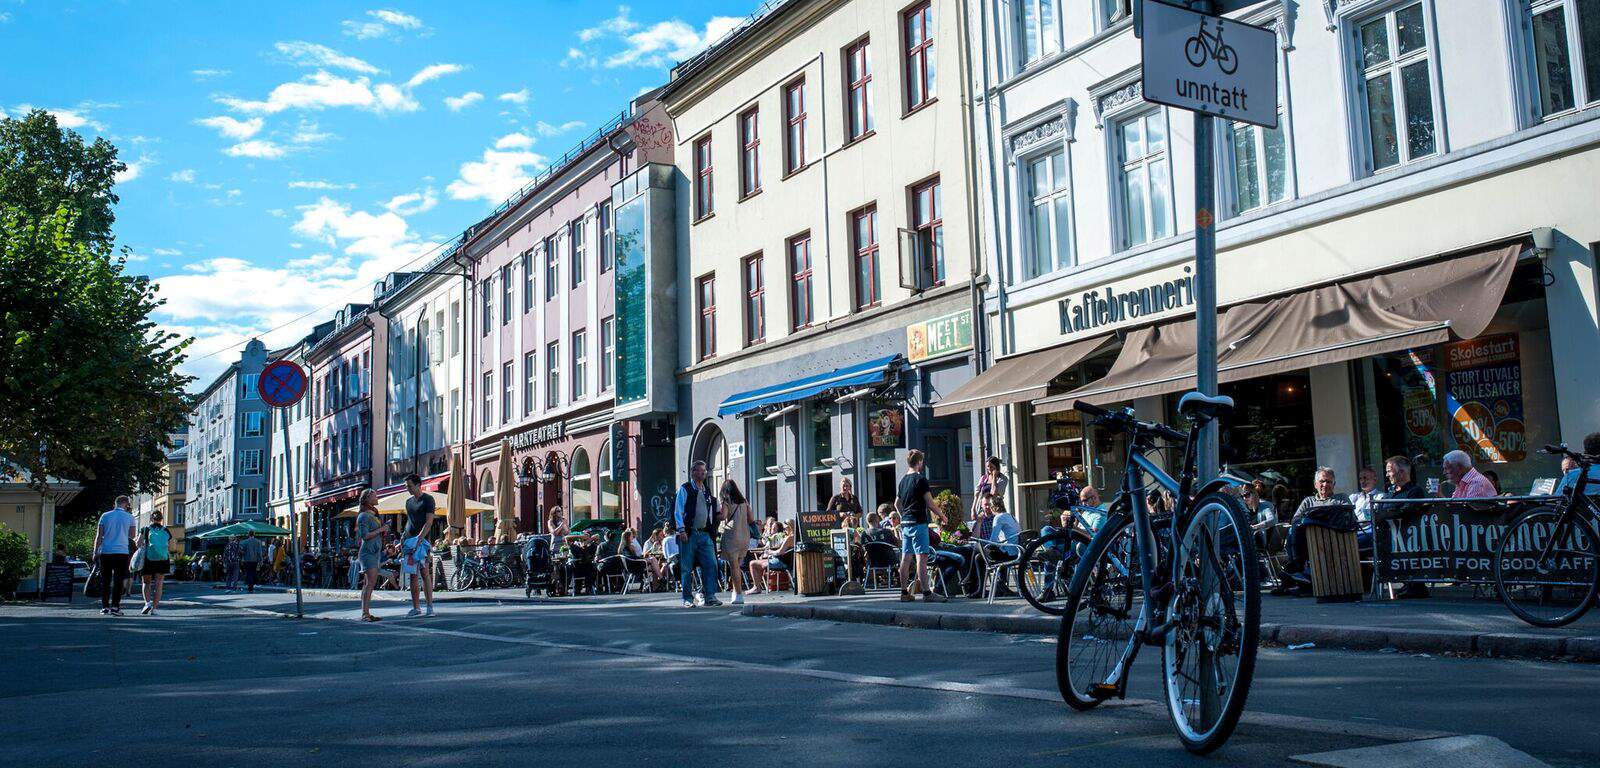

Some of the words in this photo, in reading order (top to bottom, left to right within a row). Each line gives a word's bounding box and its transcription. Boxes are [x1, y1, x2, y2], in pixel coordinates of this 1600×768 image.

[1176, 79, 1248, 111] unntatt
[1450, 338, 1515, 362] Skolestart
[1450, 370, 1480, 385] STORT
[1483, 365, 1520, 382] UTVALG
[1451, 381, 1521, 400] SKOLESAKER
[508, 421, 563, 449] PARKTEATRET
[802, 514, 837, 523] KJØKKEN
[806, 529, 820, 537] TIKI
[821, 528, 832, 537] BA
[1391, 556, 1450, 570] STEDET
[1455, 557, 1490, 570] FOR
[1501, 557, 1542, 570] GOD
